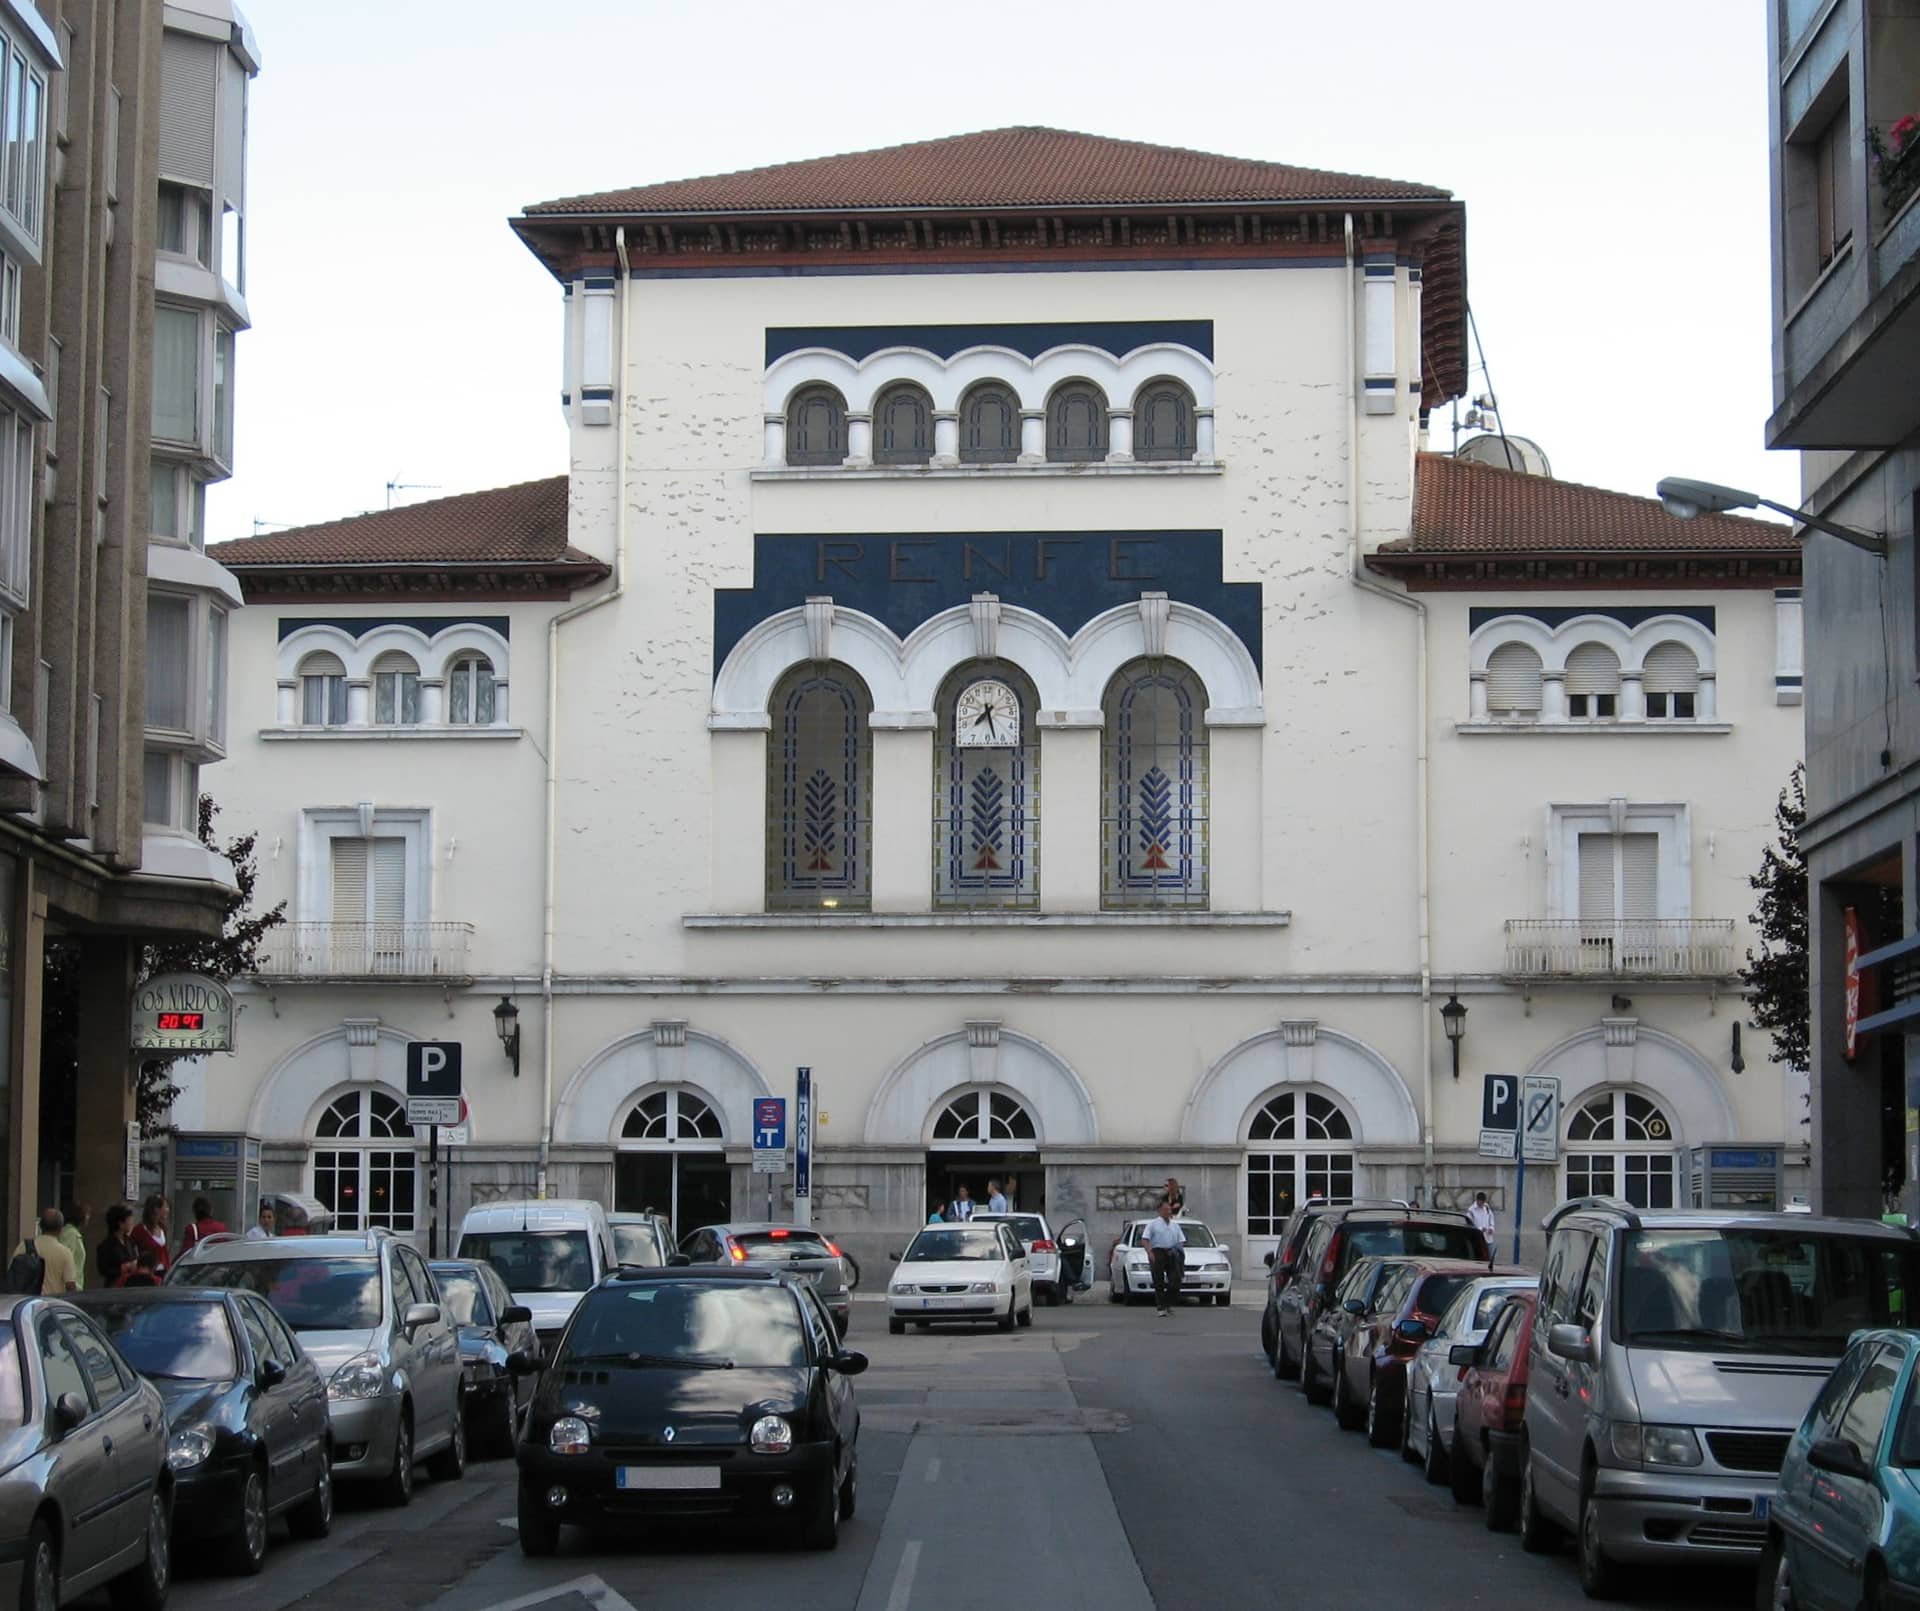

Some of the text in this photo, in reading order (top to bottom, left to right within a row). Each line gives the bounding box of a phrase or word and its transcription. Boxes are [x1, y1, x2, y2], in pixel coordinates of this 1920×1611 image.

[816, 538, 1158, 583] RENFE
[136, 984, 228, 1013] LOS NARDOS
[159, 1014, 180, 1030] 20
[132, 1039, 228, 1049] CAFETERIA
[421, 1046, 446, 1082] P
[1492, 1079, 1509, 1115] P
[760, 1127, 779, 1147] T
[799, 1102, 808, 1148] TAXI
